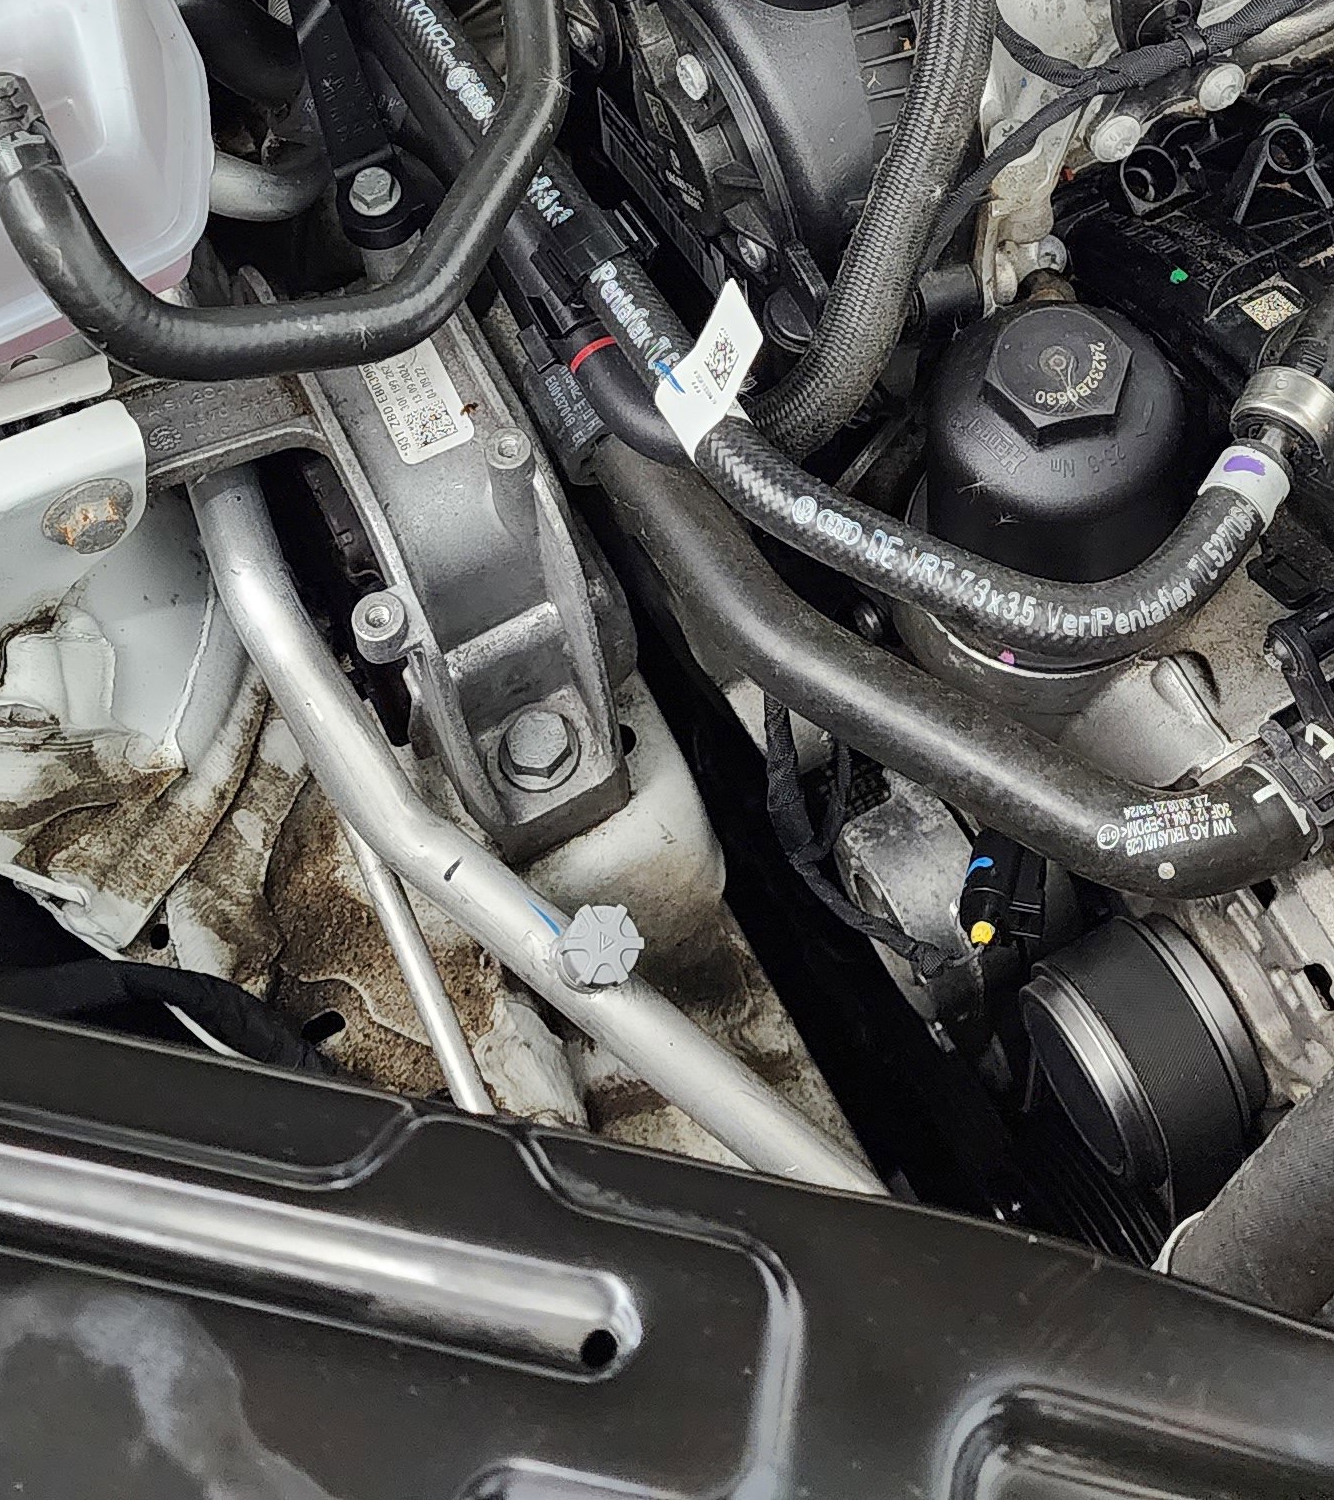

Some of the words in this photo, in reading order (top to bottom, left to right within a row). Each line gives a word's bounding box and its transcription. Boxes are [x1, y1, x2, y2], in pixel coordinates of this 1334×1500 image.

[1047, 578, 1197, 637] VeriPentaflex
[1188, 821, 1210, 841] AG
[1210, 816, 1236, 836] VW
